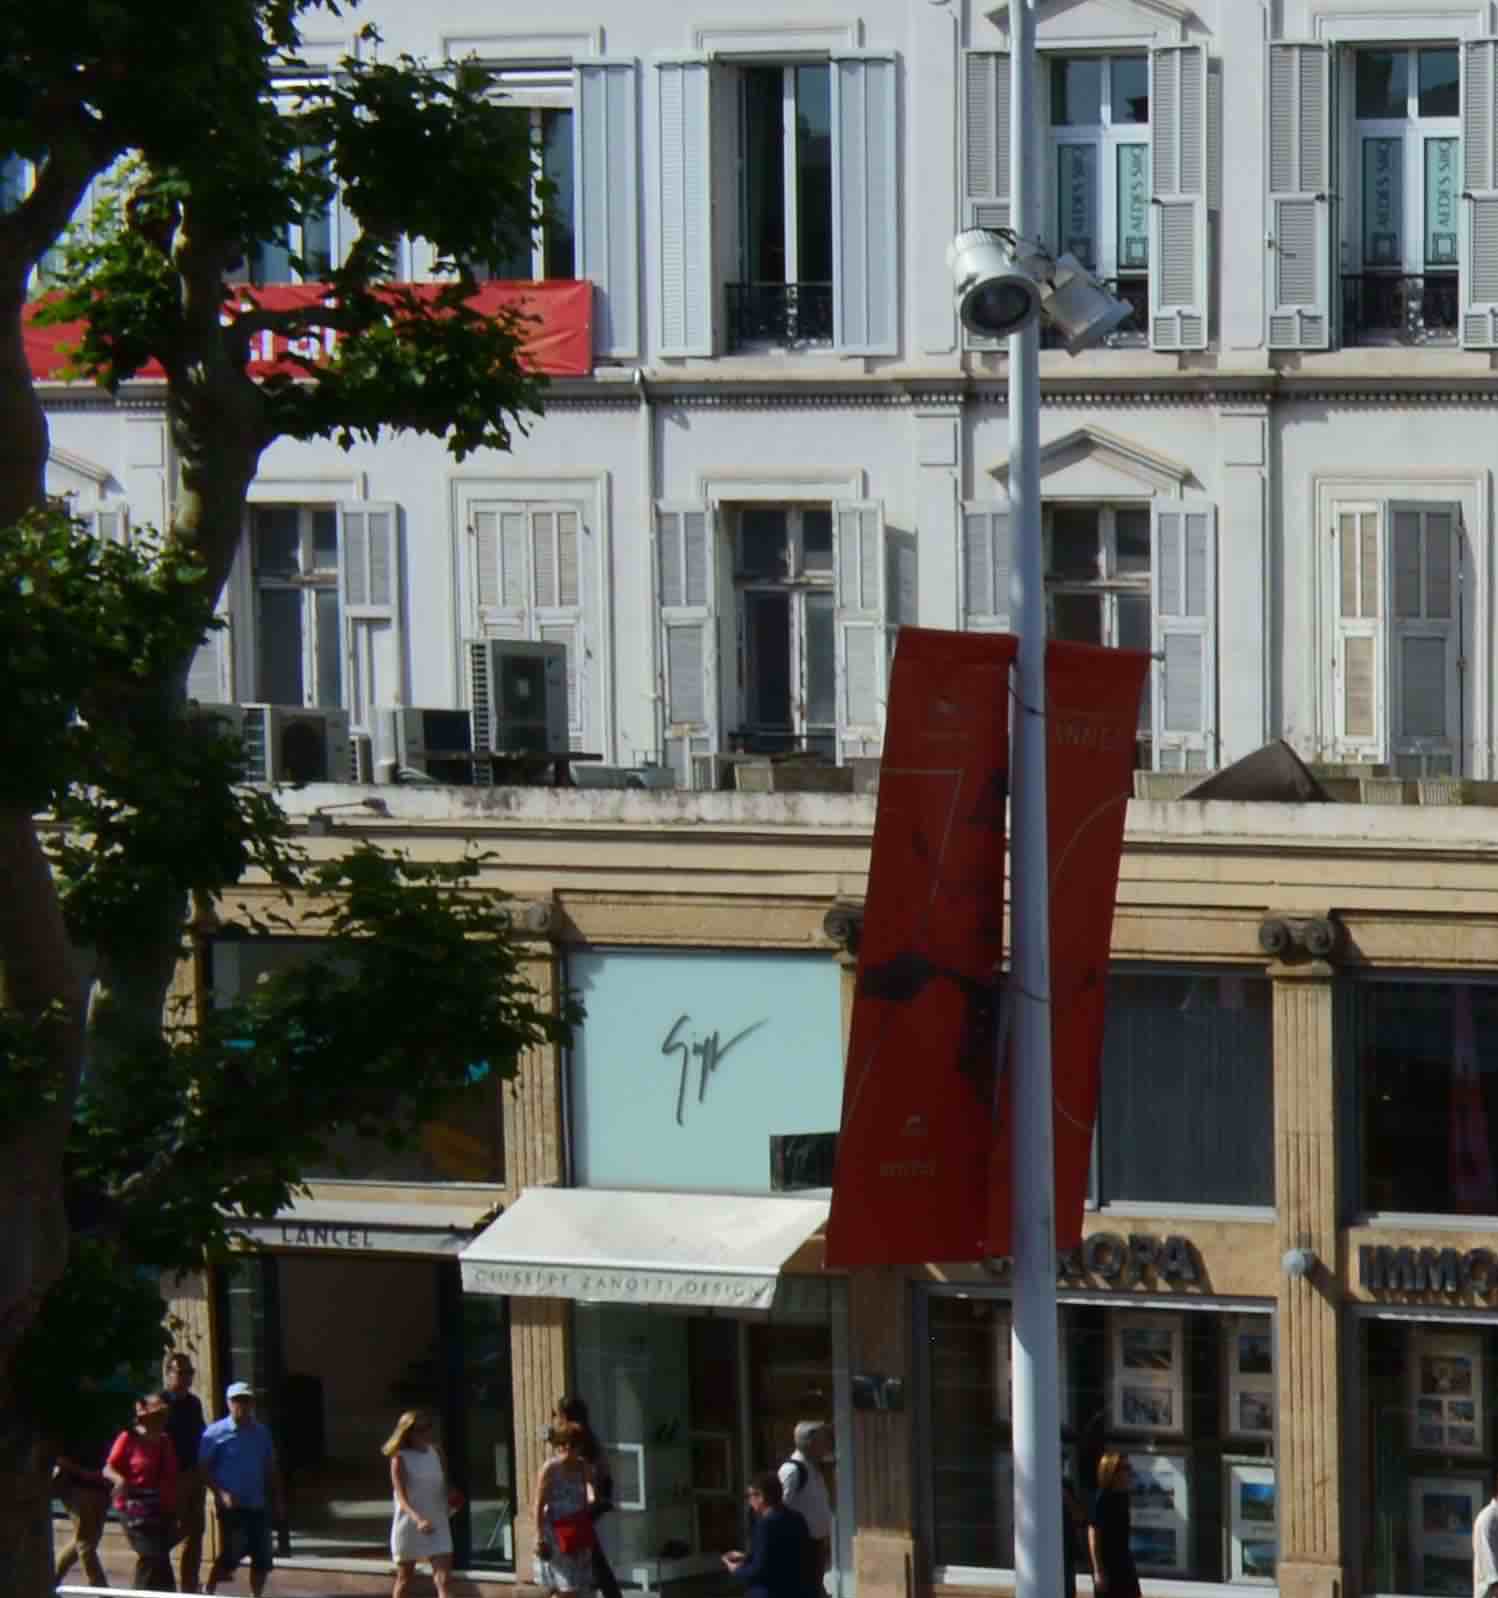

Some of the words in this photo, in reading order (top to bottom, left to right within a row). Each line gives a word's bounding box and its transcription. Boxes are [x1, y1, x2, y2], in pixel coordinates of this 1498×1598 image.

[281, 1225, 374, 1248] LANCEL
[474, 1269, 568, 1288] GIUSEPPE
[581, 1275, 673, 1295] ZANOTTI
